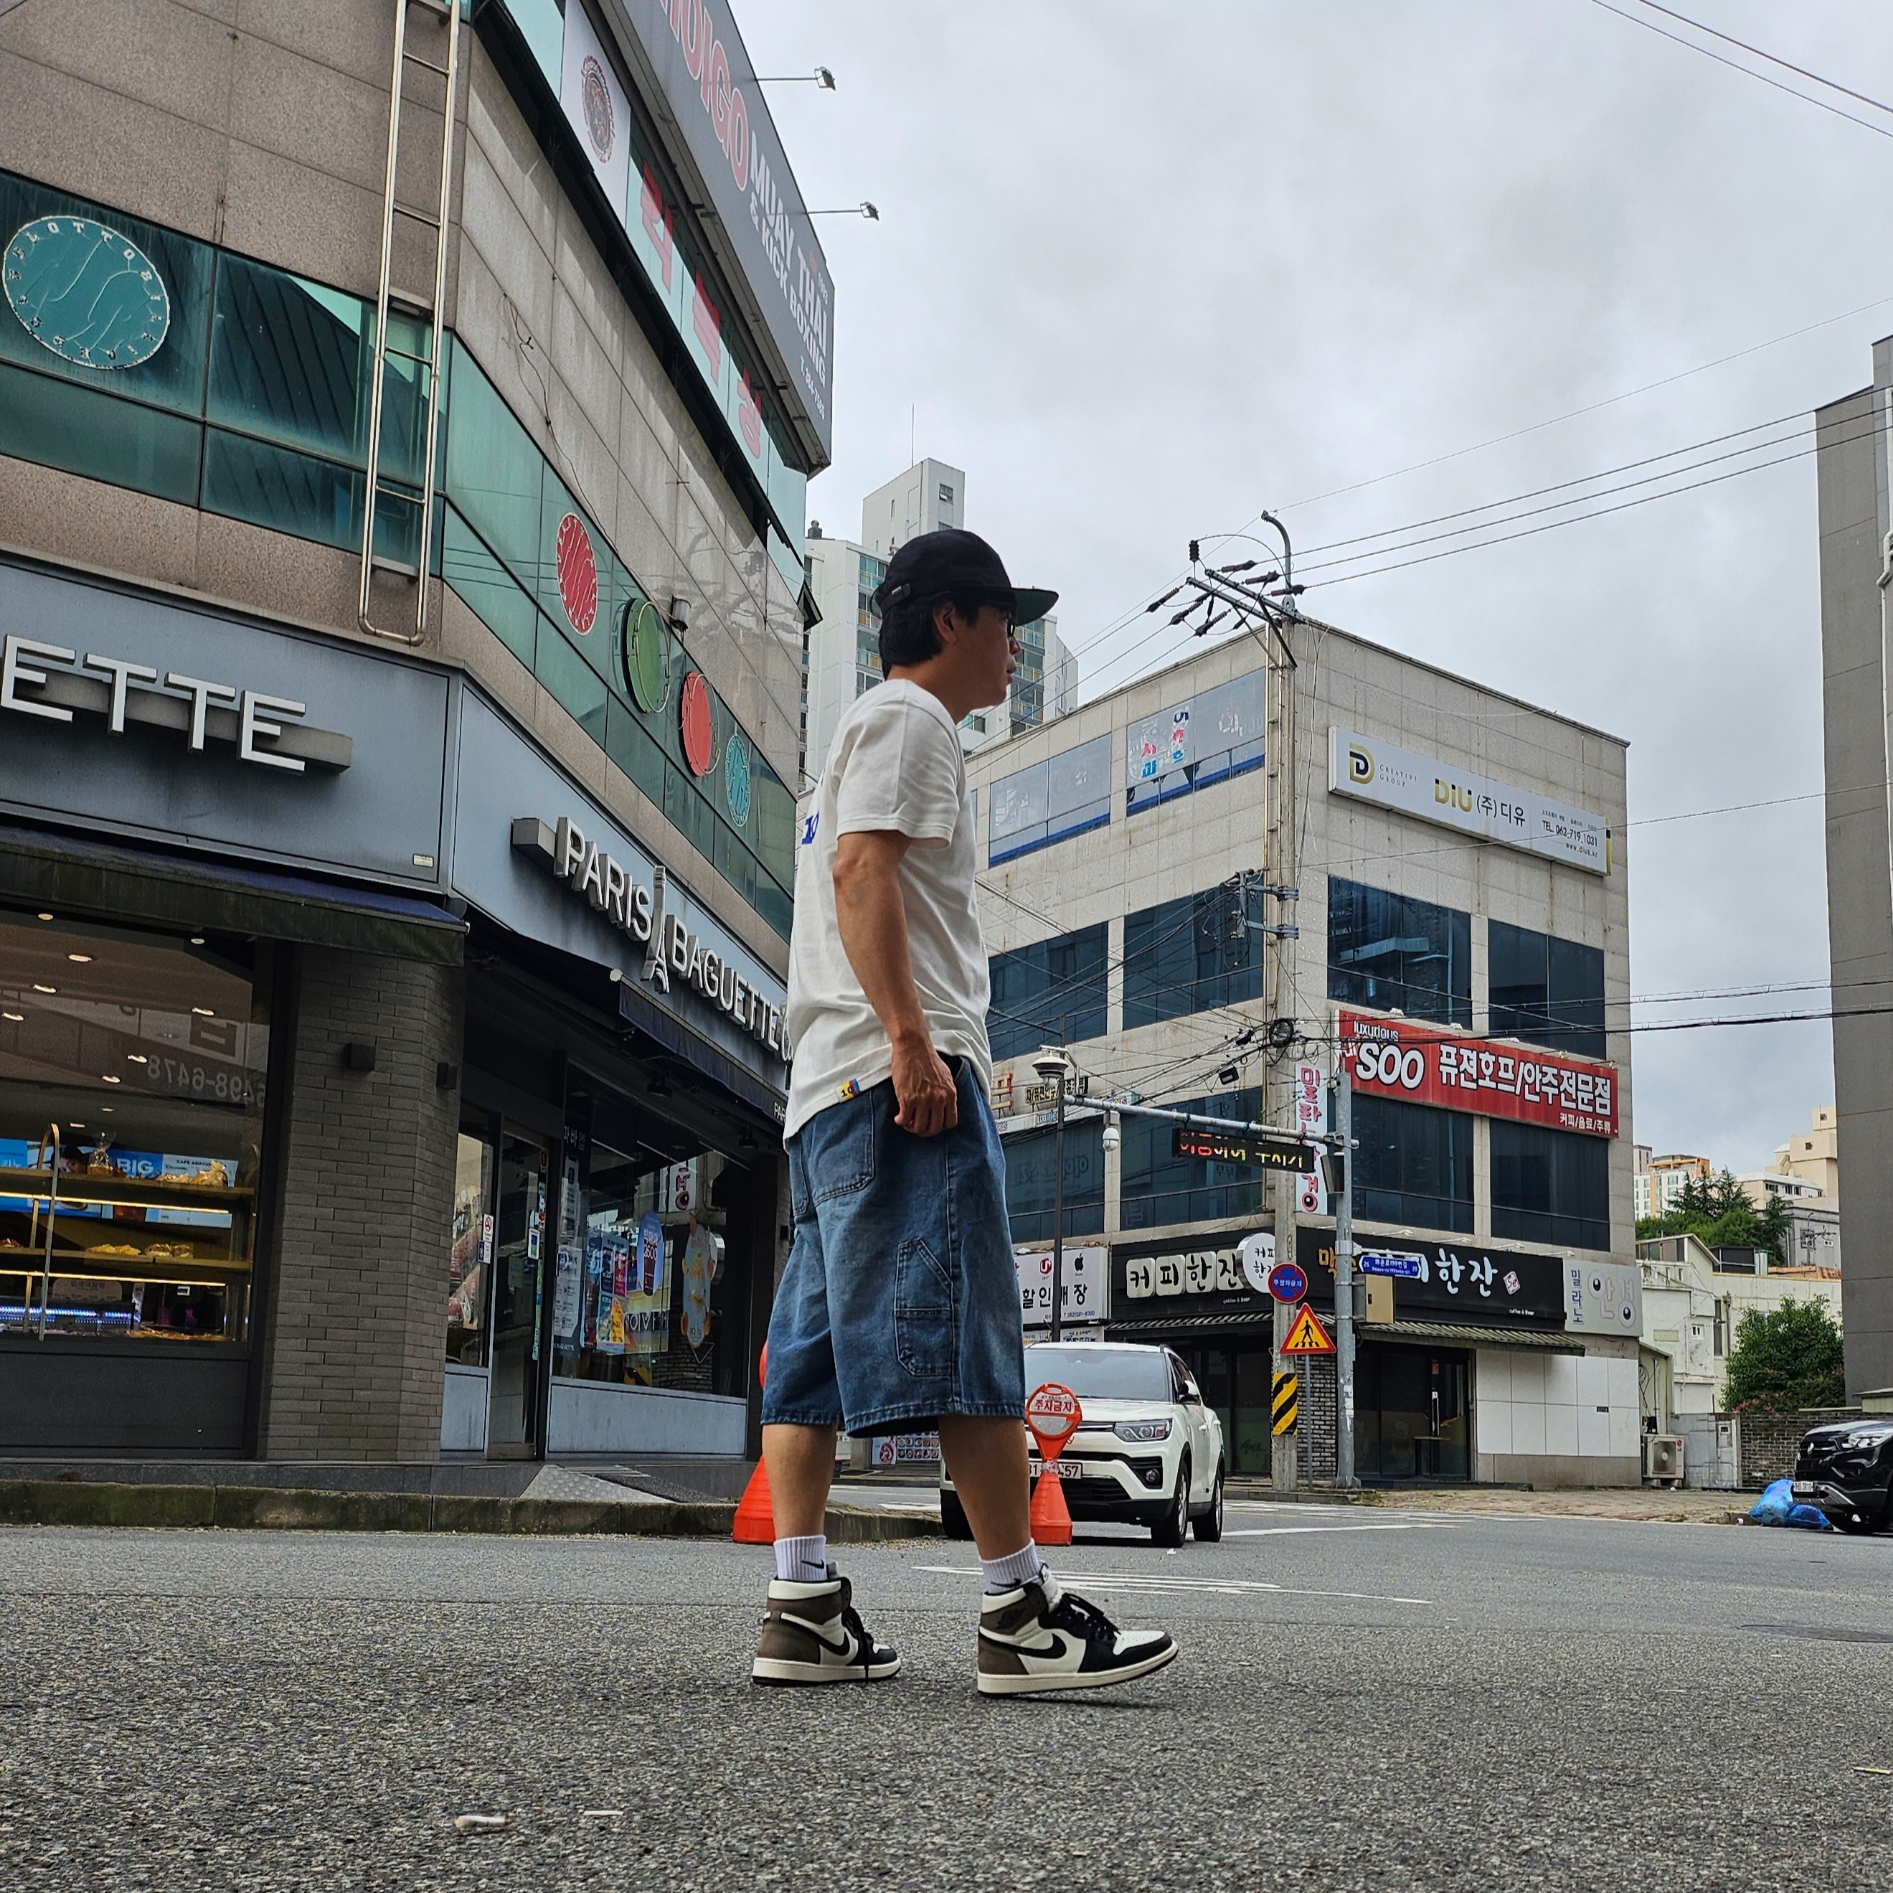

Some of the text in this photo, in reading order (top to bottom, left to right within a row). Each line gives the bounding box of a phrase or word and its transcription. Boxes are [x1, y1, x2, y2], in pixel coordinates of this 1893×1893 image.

[750, 129, 827, 358] MUAY THAI
[641, 162, 762, 459] 킥복싱
[761, 216, 788, 299] KICK
[789, 284, 826, 389] BOXING
[3, 634, 306, 771] ETTE
[1379, 774, 1407, 788] GROUP
[1476, 794, 1498, 819] (주)
[1500, 802, 1526, 828] 디유
[555, 817, 651, 942] PARIS
[665, 915, 781, 1052] BAGUETTE
[1353, 1020, 1399, 1042] luxurious
[1355, 1042, 1425, 1090] SOO
[116, 1158, 154, 1175] BIG
[1571, 1269, 1584, 1326] 밀라노
[1035, 1399, 1072, 1413] 주차금지
